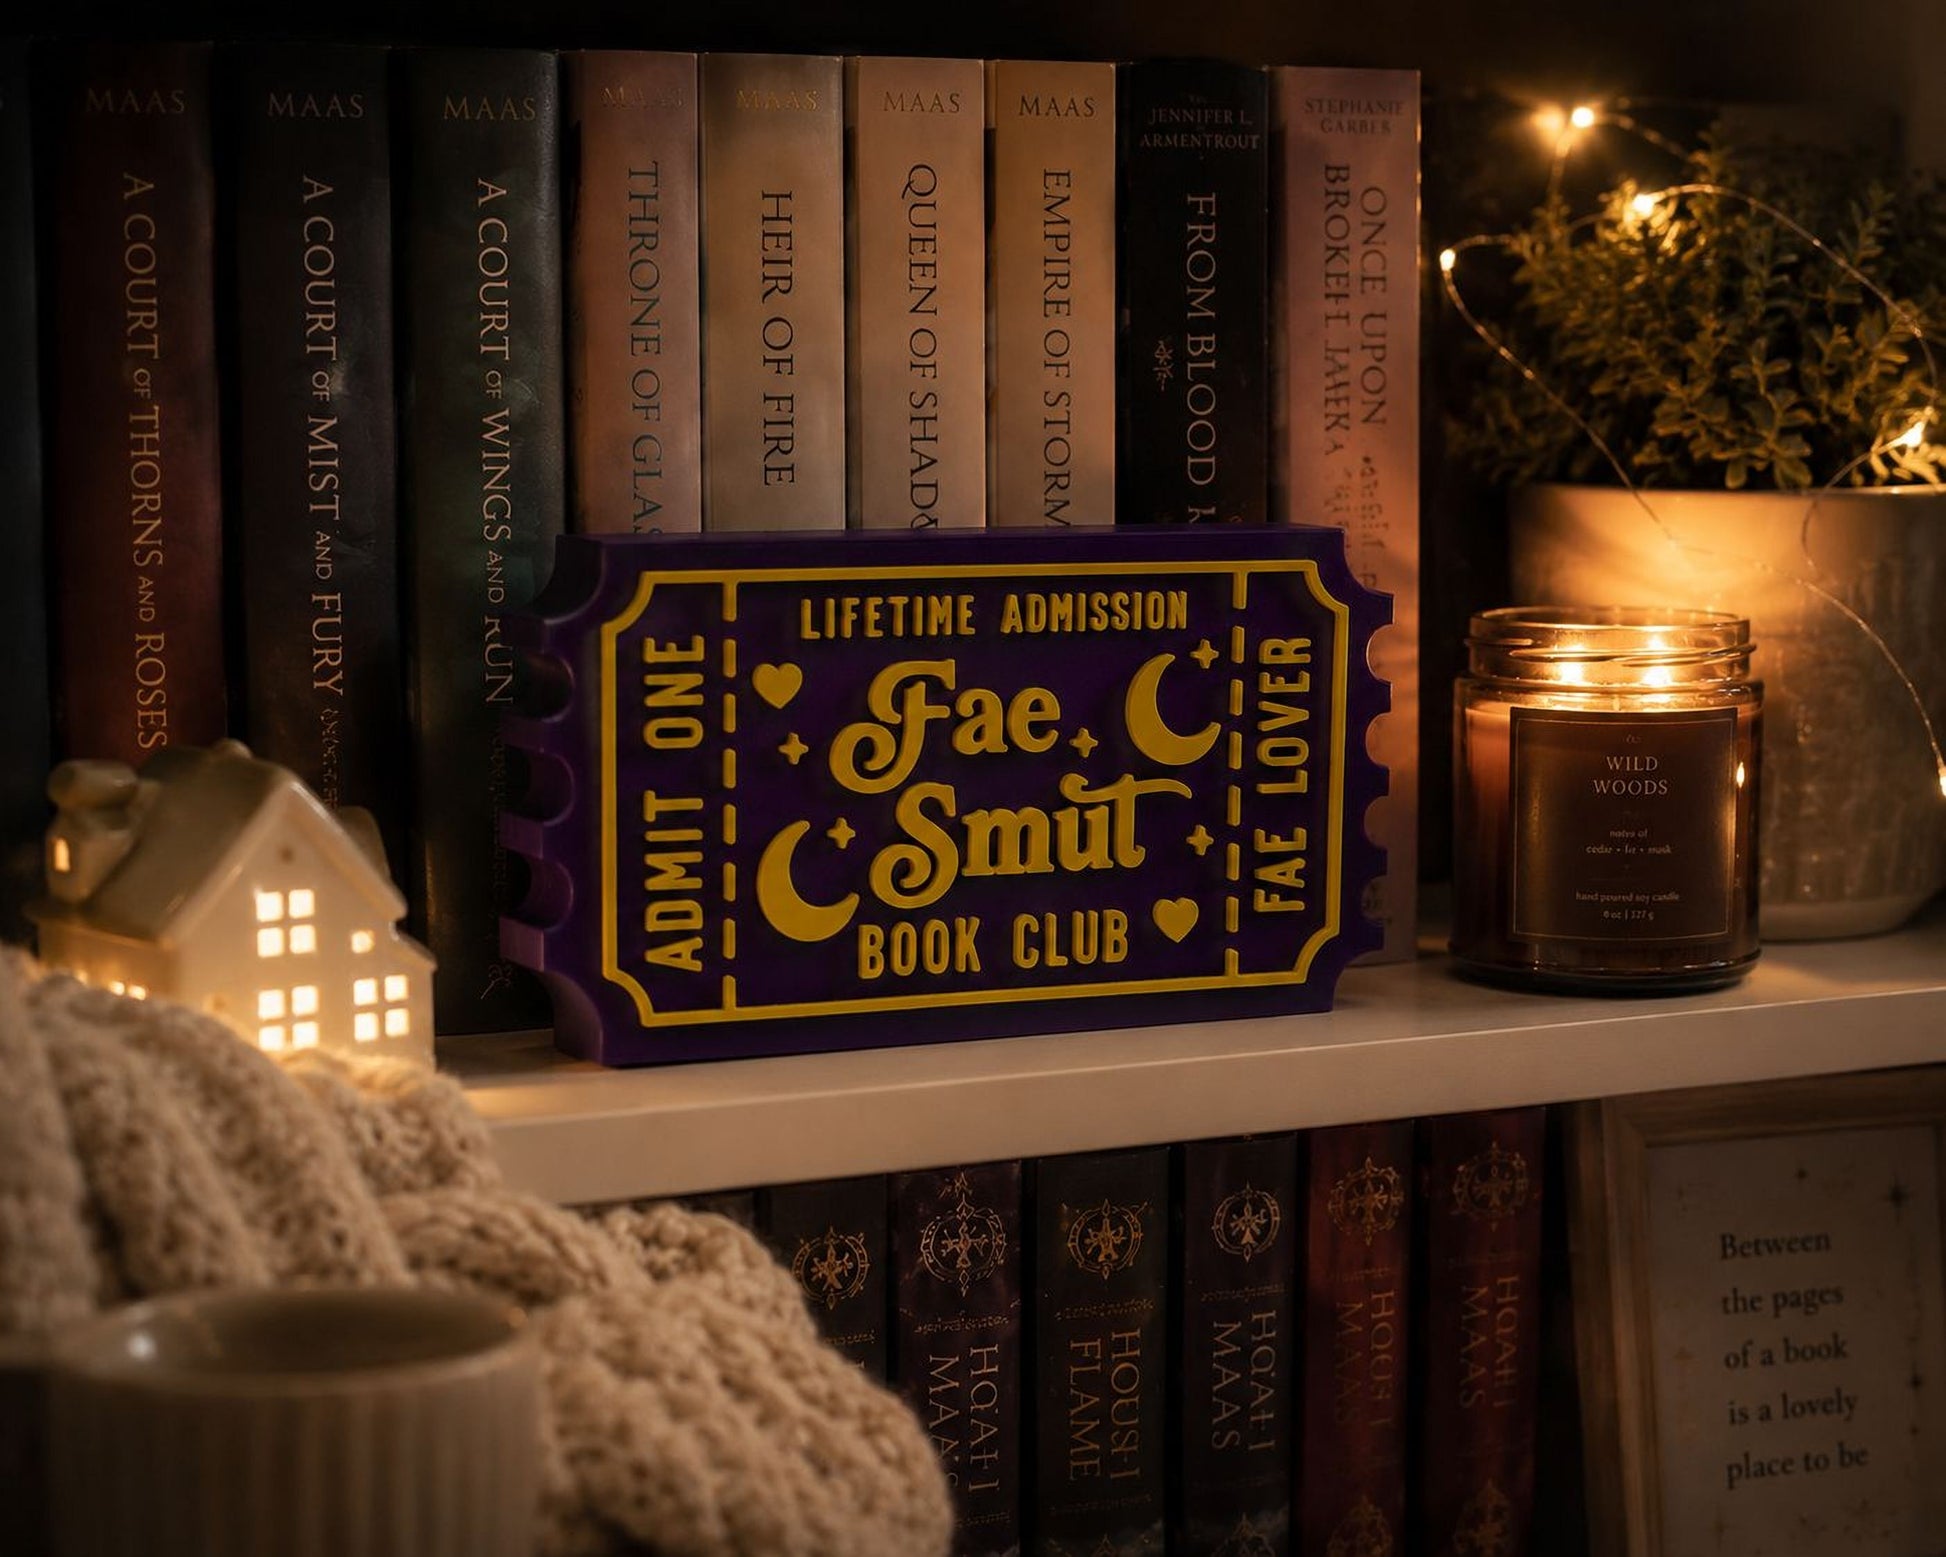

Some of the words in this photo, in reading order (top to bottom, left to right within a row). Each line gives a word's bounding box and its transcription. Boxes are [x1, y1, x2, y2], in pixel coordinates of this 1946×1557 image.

[85, 89, 187, 117] MAAS
[266, 89, 365, 119] MAAS
[443, 96, 537, 121] MAAS
[883, 92, 961, 114] MAAS
[1019, 96, 1097, 119] MAAS
[1148, 107, 1235, 128] JENNIFER
[1304, 98, 1404, 117] STEPHANIE
[1139, 132, 1261, 152] ARMENTROUT
[122, 171, 155, 200] A
[302, 174, 334, 203] A
[476, 178, 507, 206] A
[628, 160, 661, 356] THRONE
[761, 190, 793, 304] HEIR
[902, 164, 938, 316] QUEEN
[1043, 168, 1071, 318] EMPIRE
[1185, 192, 1218, 319] FROM
[1358, 186, 1388, 294] ONCE
[123, 213, 159, 360] COURT
[303, 215, 338, 361] COURT
[478, 217, 511, 361] COURT
[762, 316, 794, 376] OF
[909, 328, 938, 379] OF
[1044, 329, 1071, 378] OF
[1358, 313, 1388, 427] UPON
[132, 367, 152, 400] OF
[632, 369, 661, 422] OF
[1185, 332, 1218, 488] BLOOD
[307, 415, 340, 520] MIST
[763, 393, 795, 486] FIRE
[128, 405, 164, 568] THORNS
[482, 407, 512, 543] WINGS
[315, 530, 334, 581] AND
[488, 550, 506, 605] AND
[138, 578, 156, 624] AND
[800, 592, 977, 642] LIFETIME
[1000, 589, 1190, 637] ADMISSION
[311, 591, 344, 697] FURY
[134, 631, 168, 750] ROSES
[643, 632, 707, 751] ONE
[1256, 635, 1313, 797] LOVER
[828, 657, 1062, 797] Fae
[1592, 779, 1670, 797] WOODS
[1605, 755, 1659, 773] WILD
[868, 772, 1194, 912] Smut
[1252, 825, 1310, 914] FAE
[643, 789, 705, 974] ADMIT
[857, 915, 983, 982] BOOK
[1011, 908, 1130, 970] CLUB
[1720, 1231, 1832, 1261] Between
[1722, 1287, 1762, 1316] the
[1772, 1285, 1846, 1319] pages
[1460, 1285, 1490, 1410] MAAS
[1724, 1339, 1755, 1370] of
[1760, 1349, 1776, 1367] a
[1784, 1333, 1850, 1364] book
[1070, 1337, 1102, 1481] FLAME
[1211, 1319, 1243, 1453] MAAS
[1728, 1400, 1750, 1426] is
[1758, 1403, 1774, 1423] a
[1781, 1388, 1860, 1424] lovely
[1726, 1452, 1795, 1491] place
[1803, 1447, 1830, 1475] to
[1839, 1441, 1869, 1469] be
